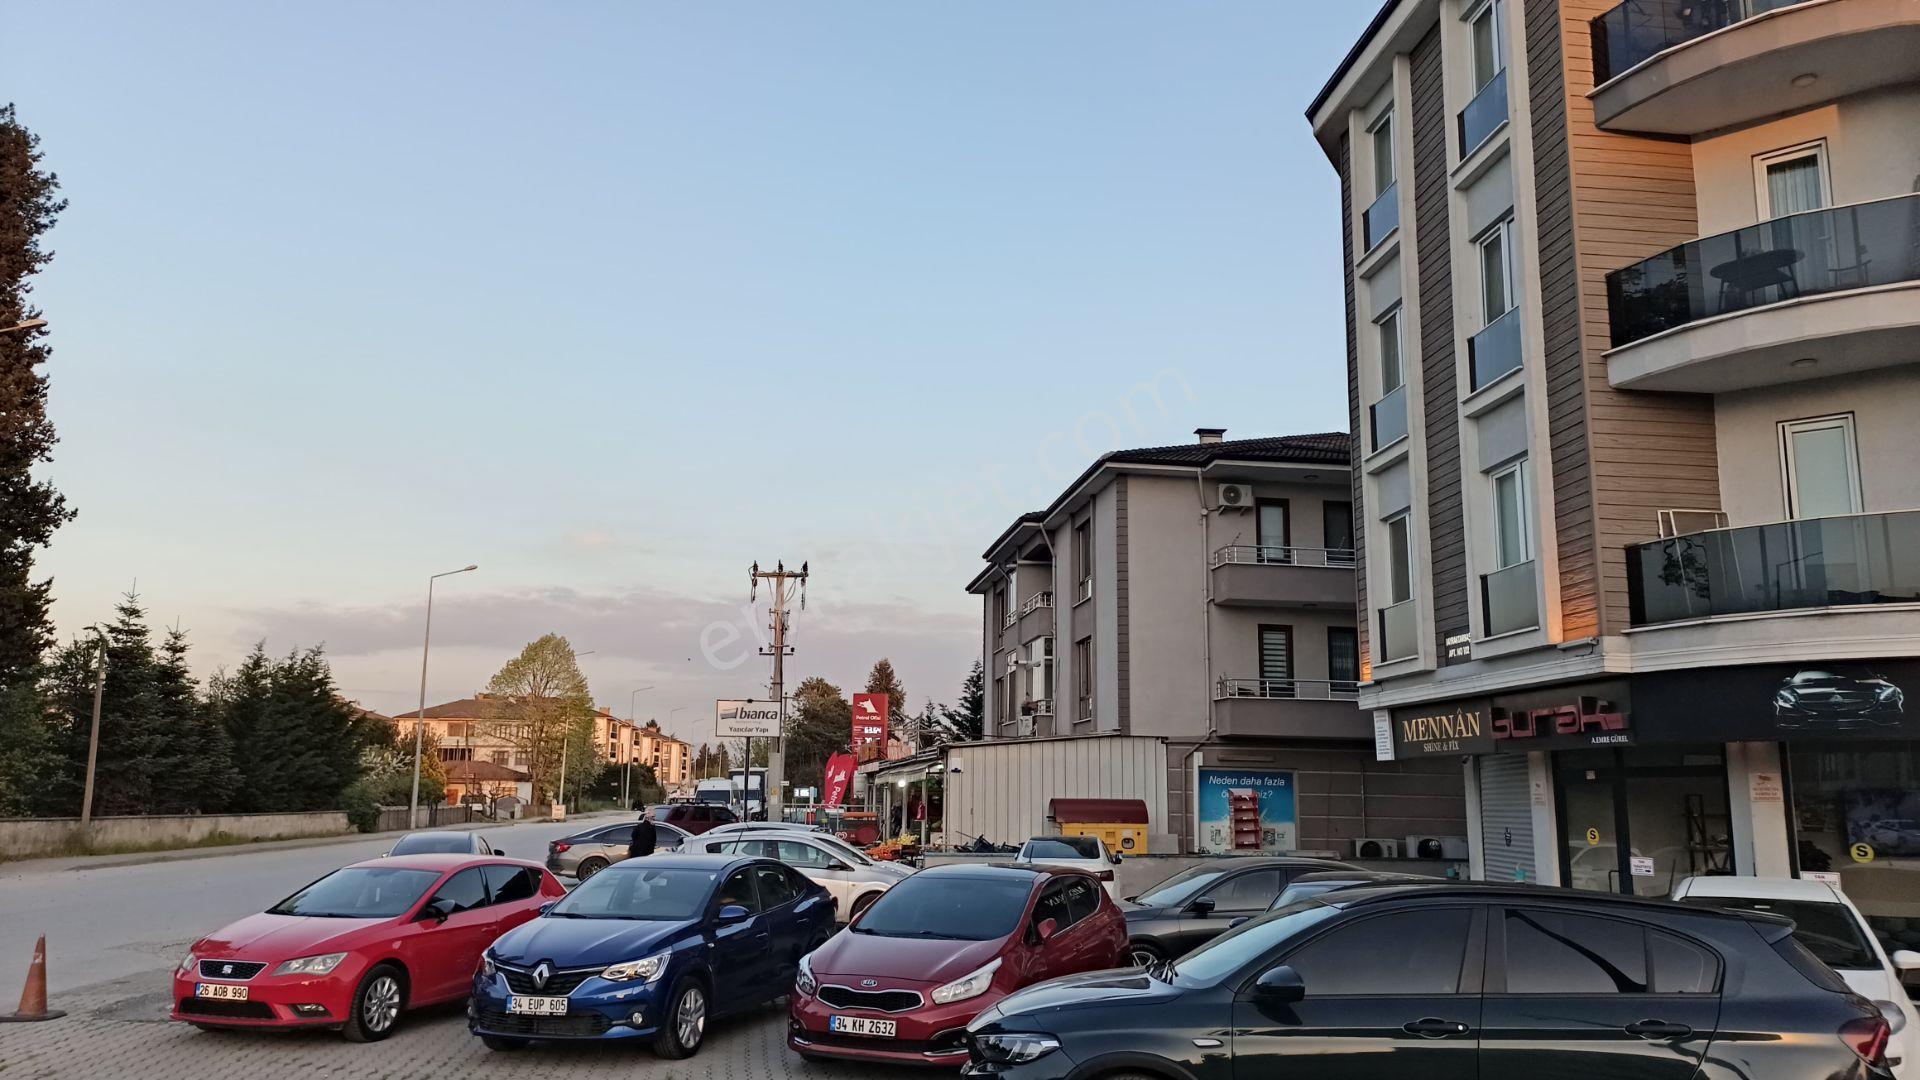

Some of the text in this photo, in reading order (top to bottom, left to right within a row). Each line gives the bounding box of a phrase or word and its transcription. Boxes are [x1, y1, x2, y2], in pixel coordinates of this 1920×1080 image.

[739, 706, 778, 720] bianca
[1402, 708, 1480, 743] MENNÂN
[1442, 741, 1448, 751] &
[1208, 775, 1285, 786] Neden daha fazla
[200, 985, 209, 996] 26
[512, 998, 566, 1011] 34 EUP 605
[836, 1017, 895, 1035] 34 KH 2632
